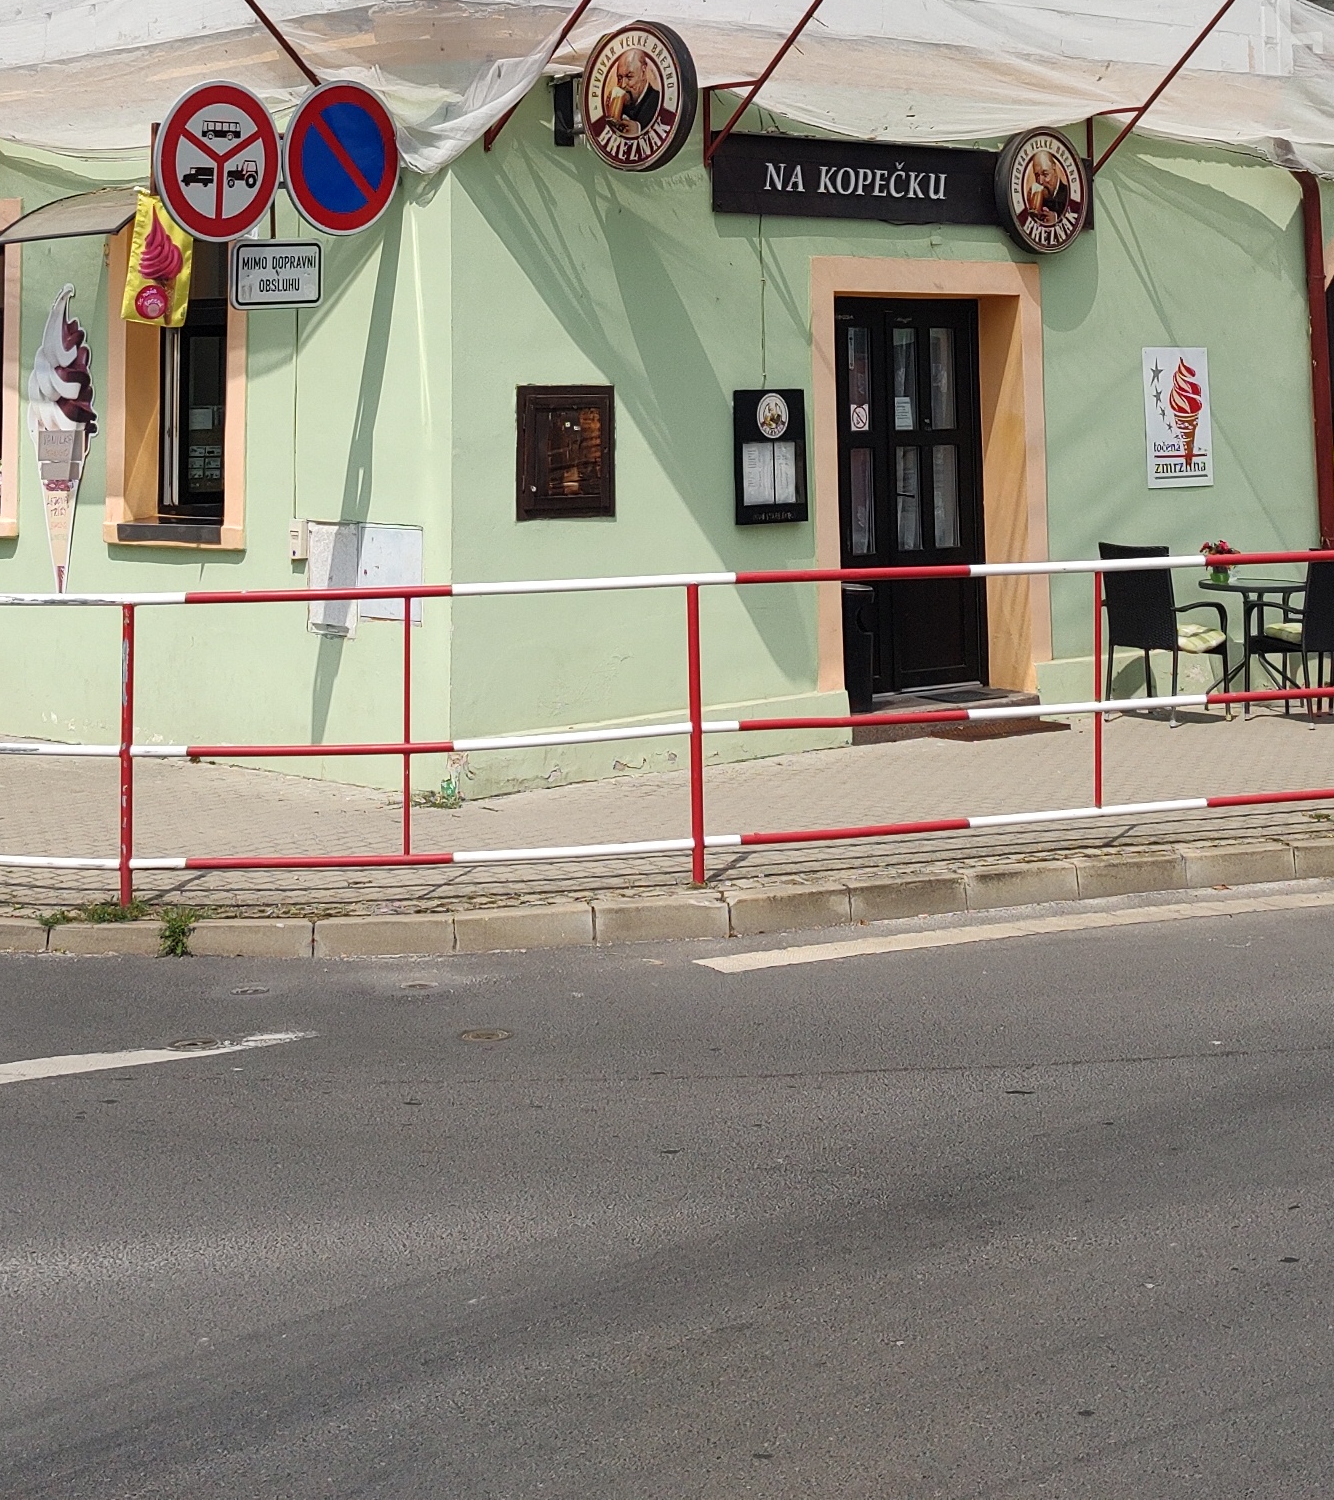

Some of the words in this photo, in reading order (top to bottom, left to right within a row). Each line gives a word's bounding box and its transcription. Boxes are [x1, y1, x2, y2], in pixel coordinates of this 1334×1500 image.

[591, 47, 617, 98] PIVOVAR
[619, 35, 649, 49] VELKÉ
[763, 162, 806, 192] NA
[817, 161, 948, 200] KOPEČKU
[242, 256, 267, 270] MIMO
[272, 251, 317, 270] DOPRAVNÍ
[259, 277, 300, 292] OBSLUHU
[1153, 441, 1181, 452] točená
